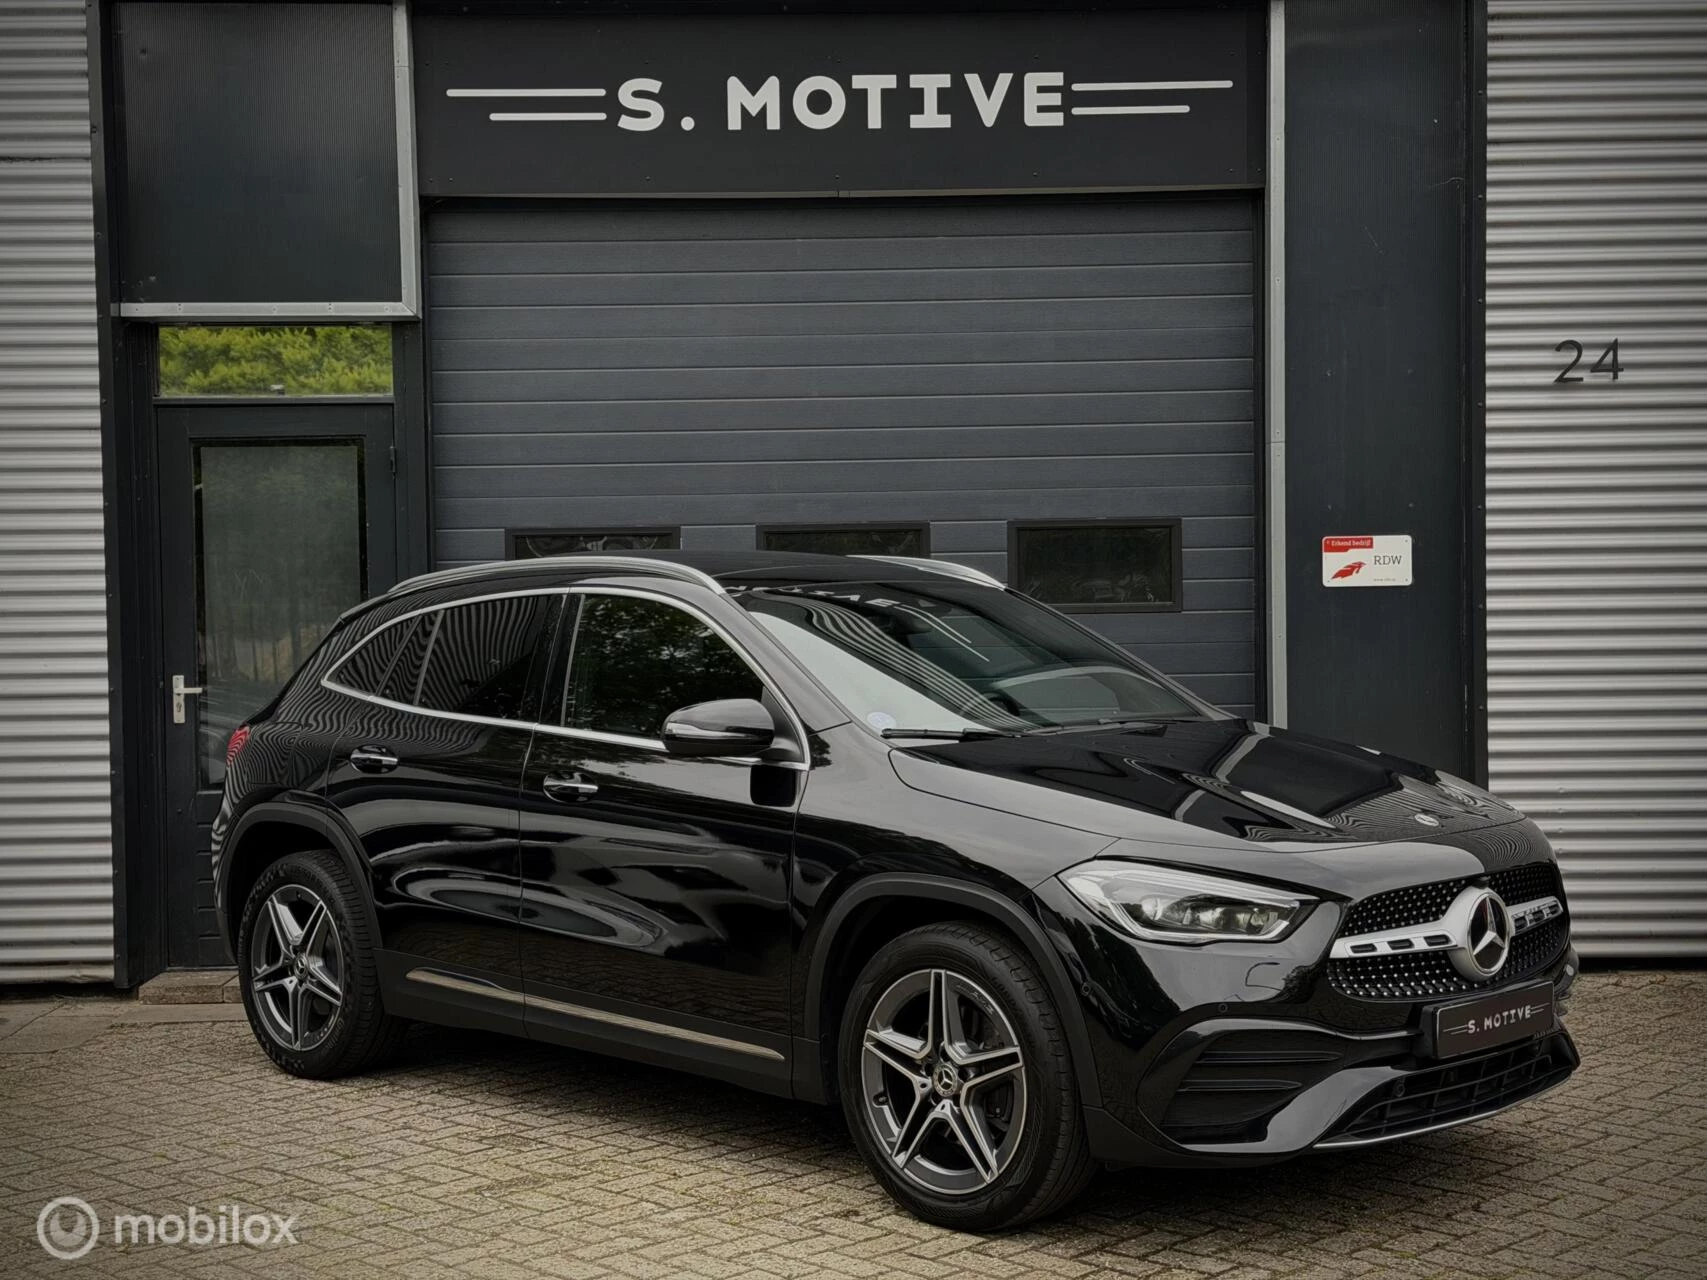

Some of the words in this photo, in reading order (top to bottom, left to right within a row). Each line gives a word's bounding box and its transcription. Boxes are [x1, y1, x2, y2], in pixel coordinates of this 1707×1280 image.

[617, 77, 695, 132] S.
[726, 71, 1065, 131] MOTIVE
[1553, 338, 1625, 384] 24
[1373, 555, 1402, 566] RDW
[1467, 1020, 1480, 1034] S.
[1483, 1004, 1532, 1031] MOTIVE
